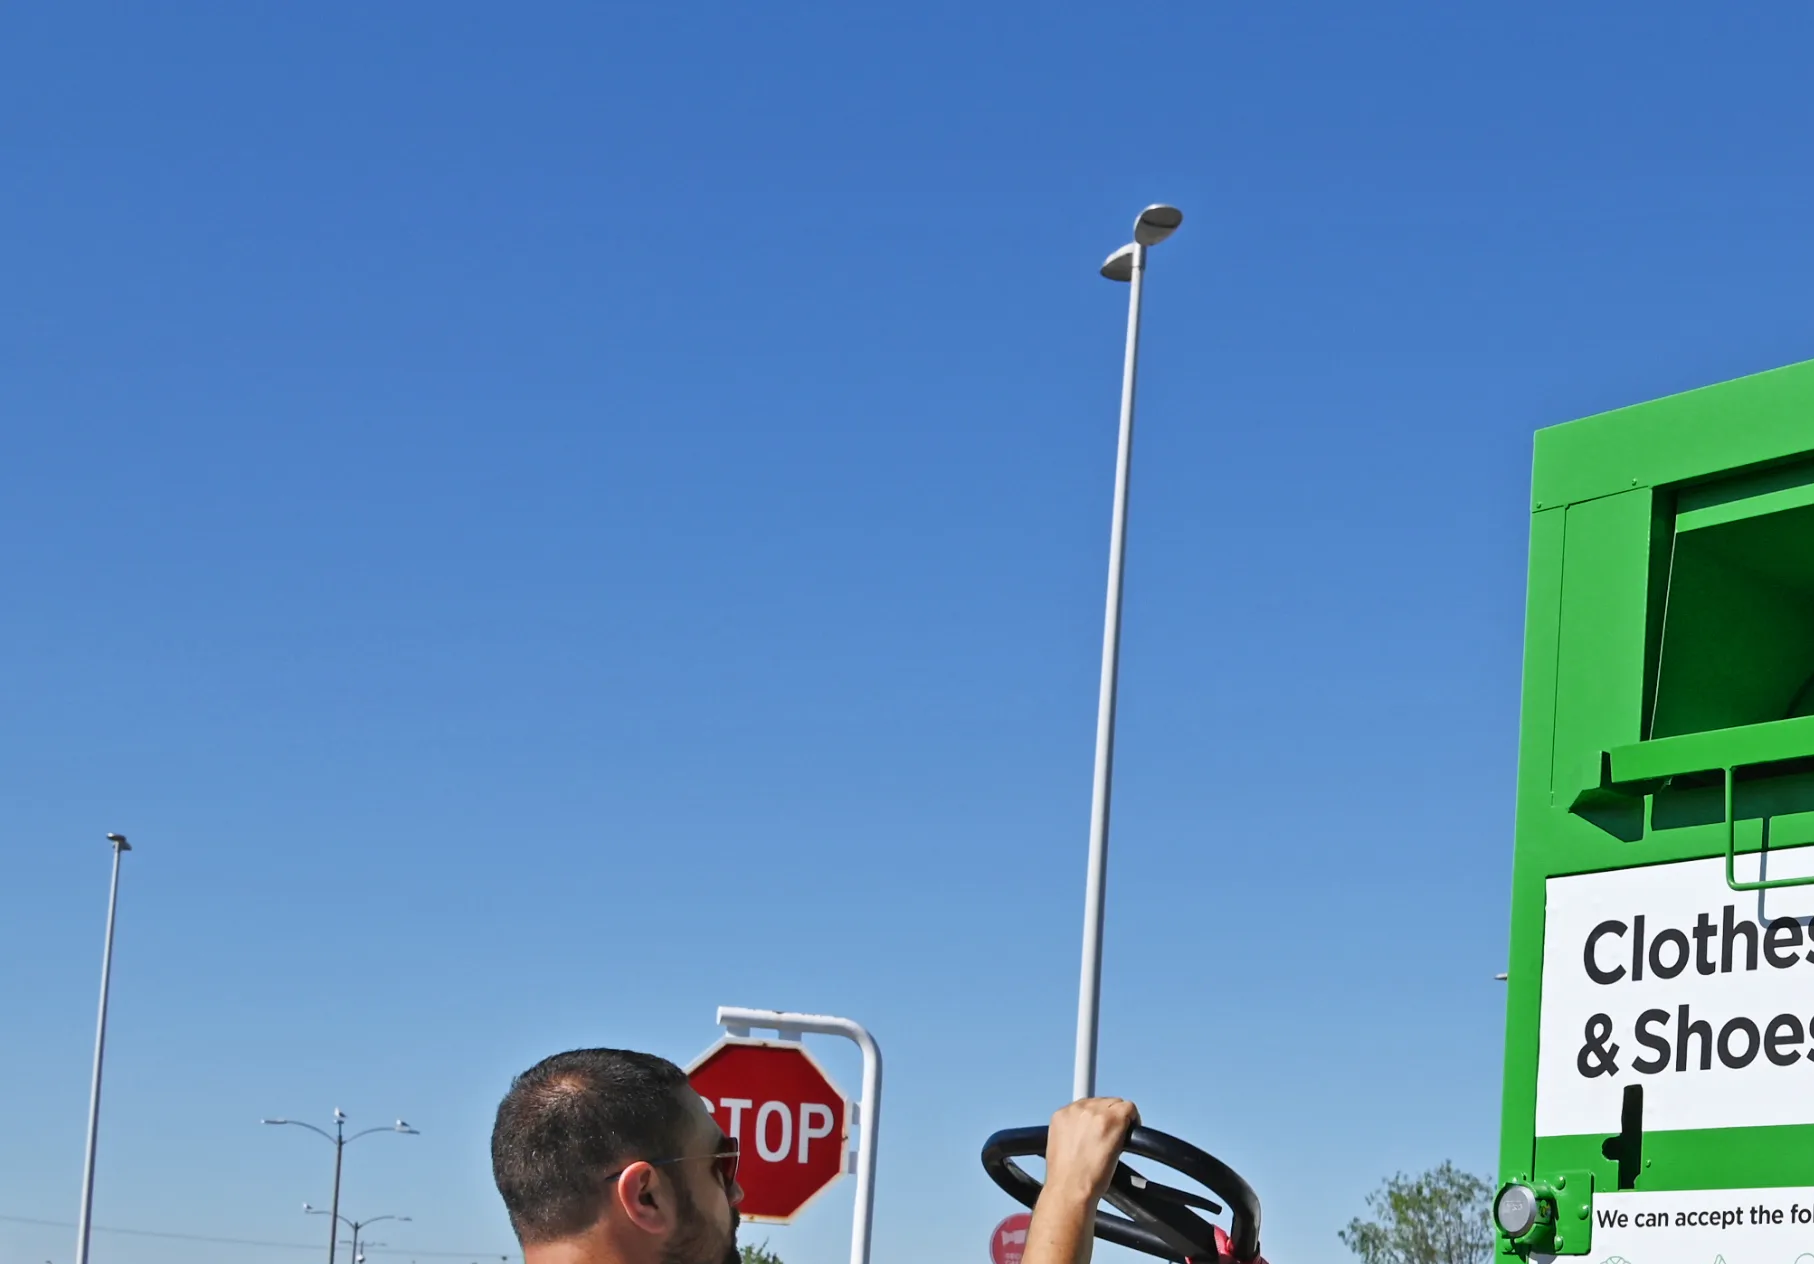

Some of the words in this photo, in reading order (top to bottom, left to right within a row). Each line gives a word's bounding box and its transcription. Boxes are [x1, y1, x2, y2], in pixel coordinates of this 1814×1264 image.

[1577, 1013, 1620, 1078] &
[700, 1096, 834, 1164] TOP
[1596, 1209, 1629, 1228] We
[1634, 1212, 1669, 1228] can
[1675, 1207, 1744, 1230] accept
[1749, 1204, 1784, 1225] the
